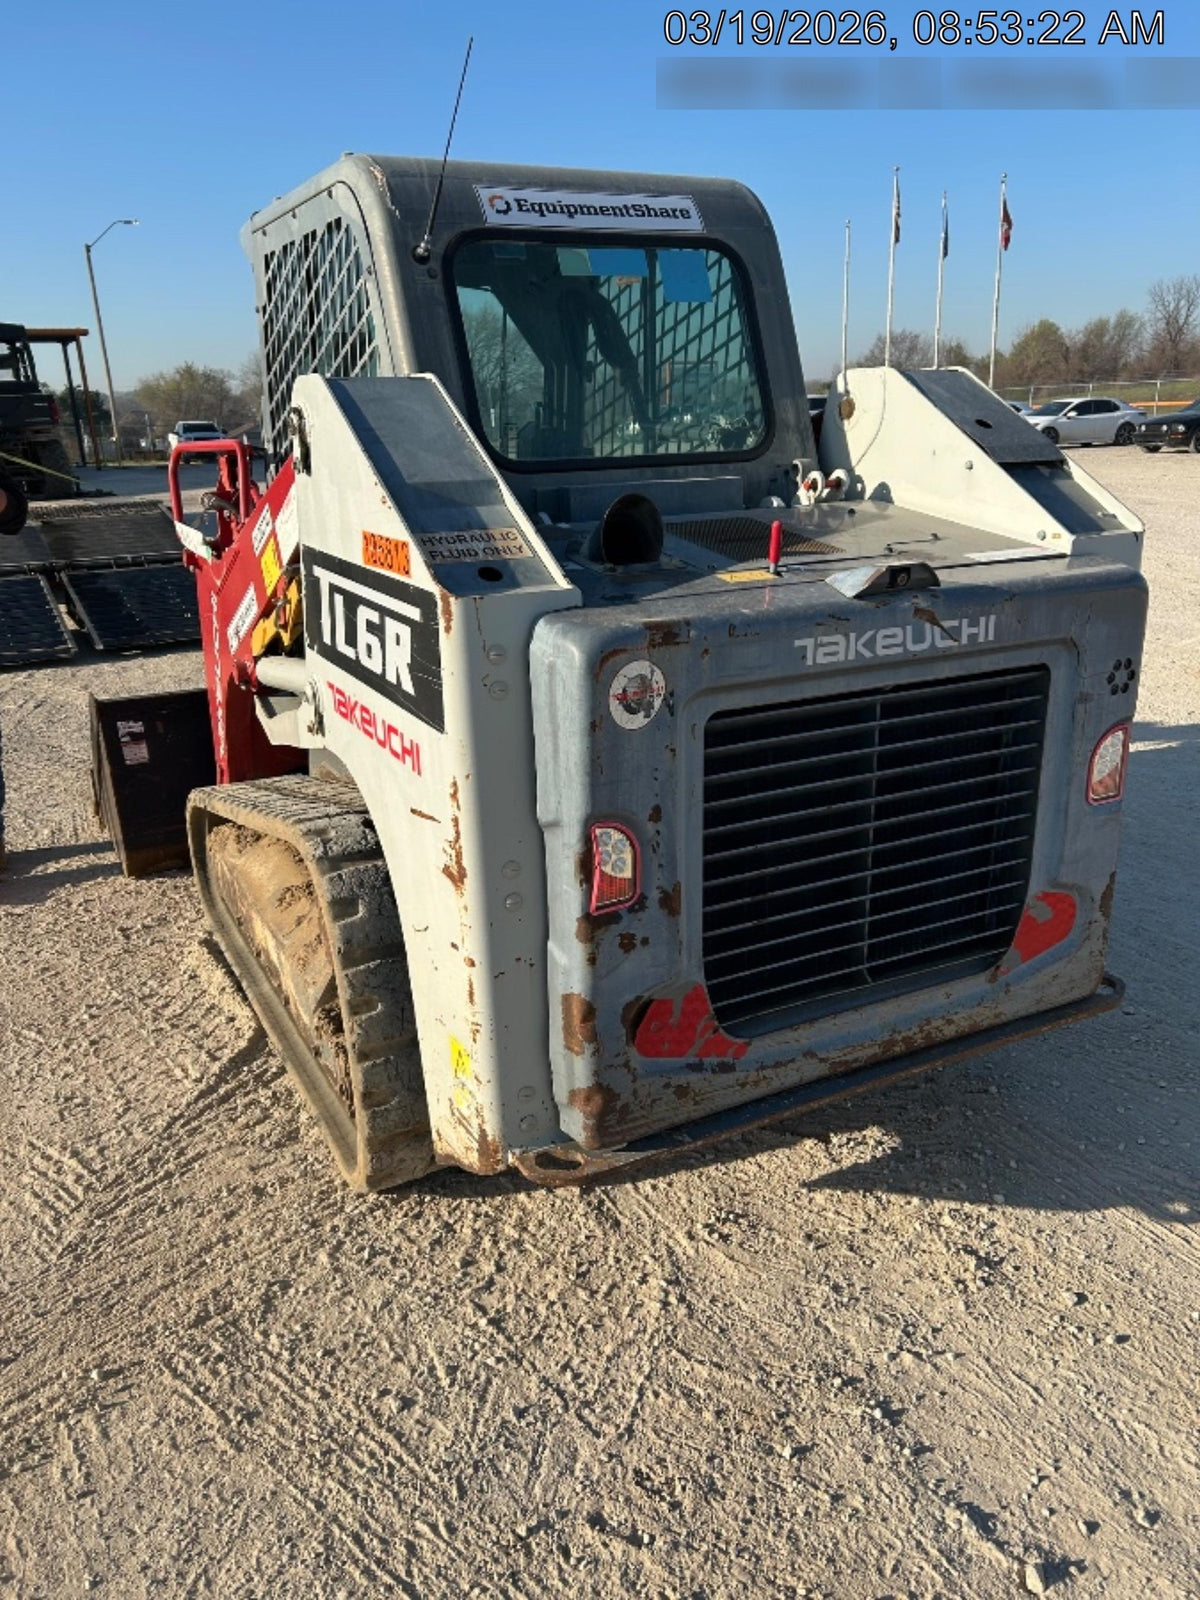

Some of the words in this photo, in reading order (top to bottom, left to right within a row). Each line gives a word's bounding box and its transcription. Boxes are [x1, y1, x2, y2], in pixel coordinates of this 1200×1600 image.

[514, 198, 692, 219] EquipmentShare
[421, 531, 518, 546] HYDRAULIC
[428, 549, 479, 560] FLUID
[482, 545, 523, 556] ONLY
[312, 565, 421, 697] TL6R
[794, 614, 997, 666] TAKEUCHI
[326, 681, 421, 777] TAKEUCHI
